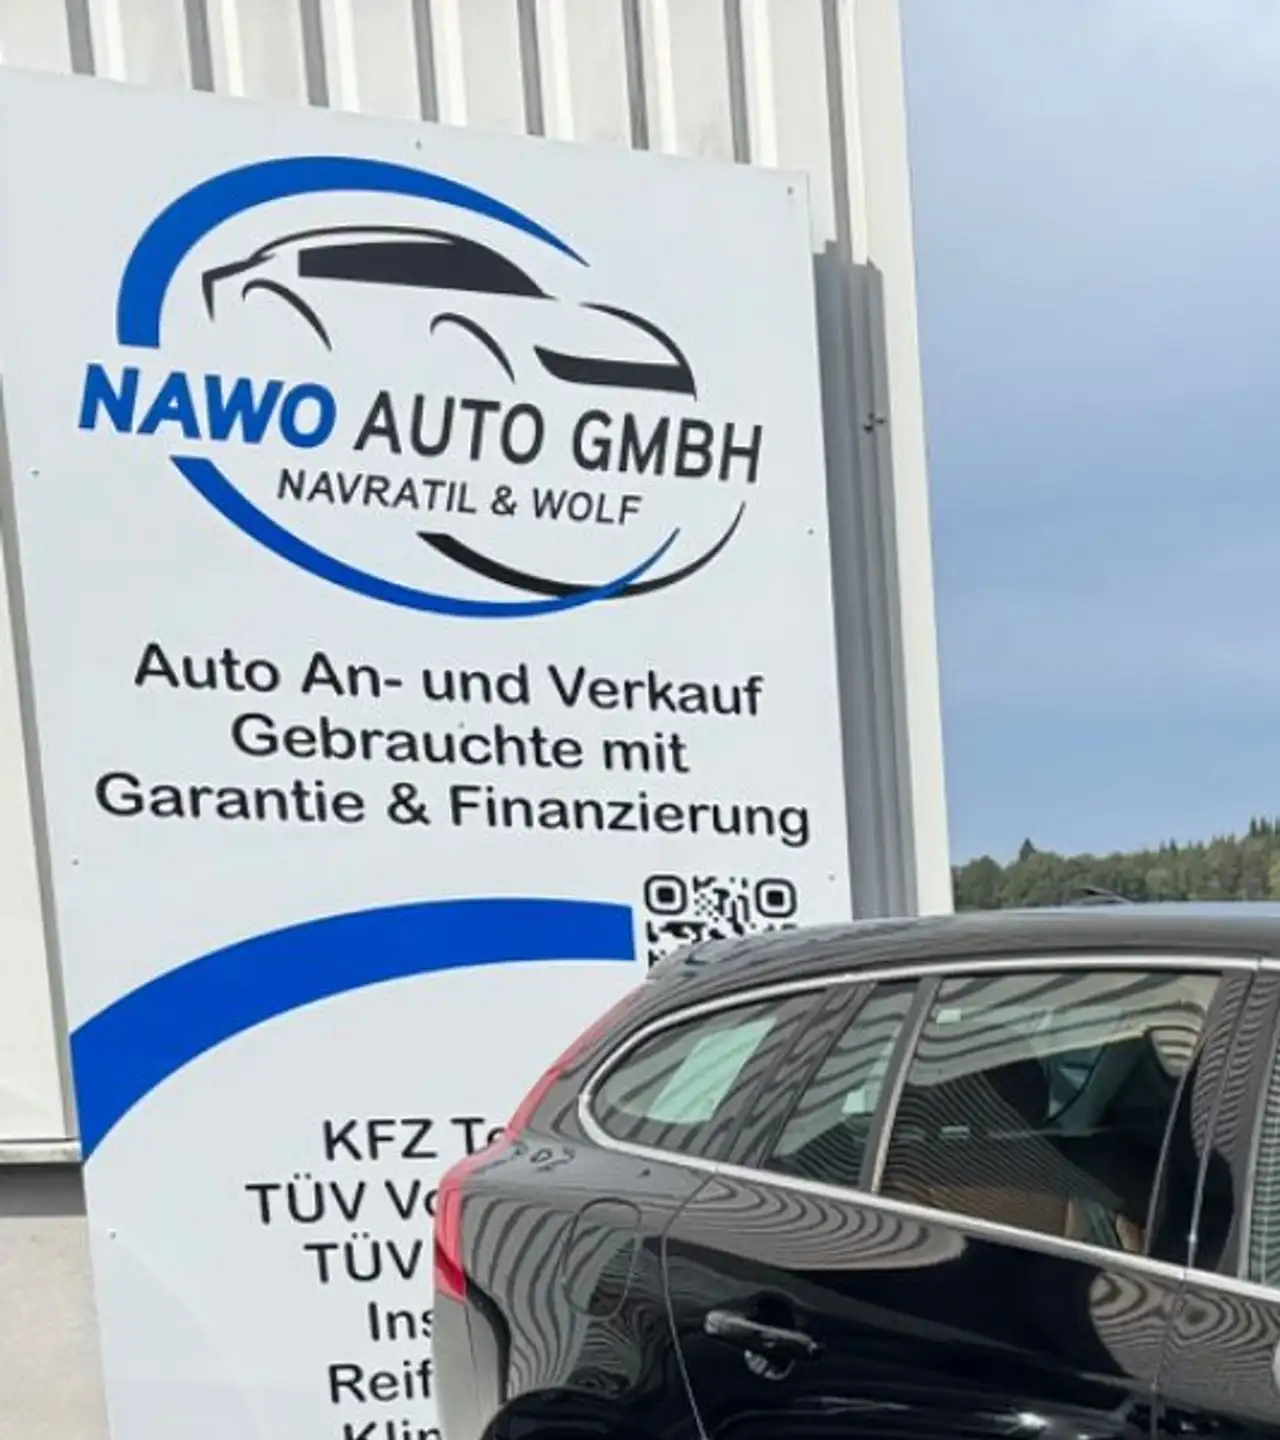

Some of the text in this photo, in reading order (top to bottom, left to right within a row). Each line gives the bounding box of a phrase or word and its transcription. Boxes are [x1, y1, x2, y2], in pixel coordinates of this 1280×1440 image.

[78, 363, 763, 483] NAWO AUTO GMBH
[277, 468, 642, 525] NAVRATIL & WOLF
[134, 642, 763, 718] Auto An- und Verkauf
[231, 712, 690, 774] Gebrauchte mit
[95, 772, 809, 848] Garantie & Finanzierung
[323, 1117, 438, 1161] KFZ
[244, 1172, 366, 1225] TÜV
[303, 1232, 423, 1284] TÜV
[328, 1358, 433, 1404] Reif
